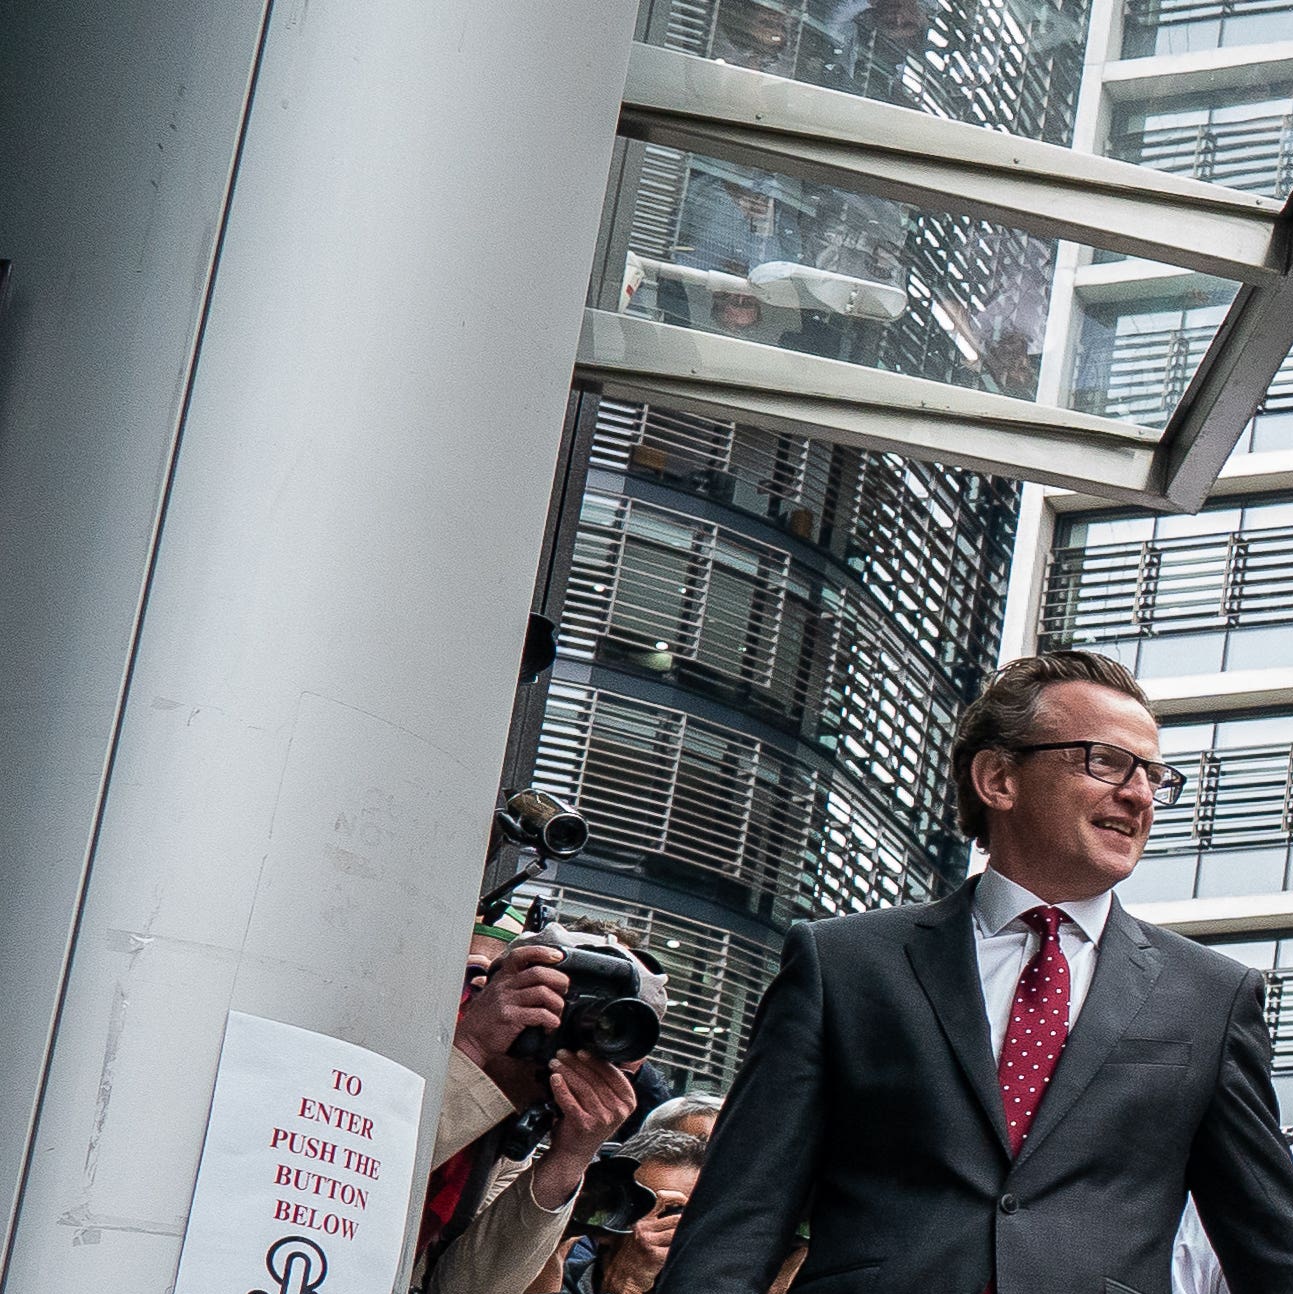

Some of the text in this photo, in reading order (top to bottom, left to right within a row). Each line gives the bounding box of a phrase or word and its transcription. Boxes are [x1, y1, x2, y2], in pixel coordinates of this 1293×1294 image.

[331, 1069, 362, 1097] TO
[297, 1097, 374, 1140] ENTER
[269, 1127, 381, 1181] PUSH THE
[273, 1164, 369, 1210] BUTTON
[273, 1199, 359, 1241] BELOW
